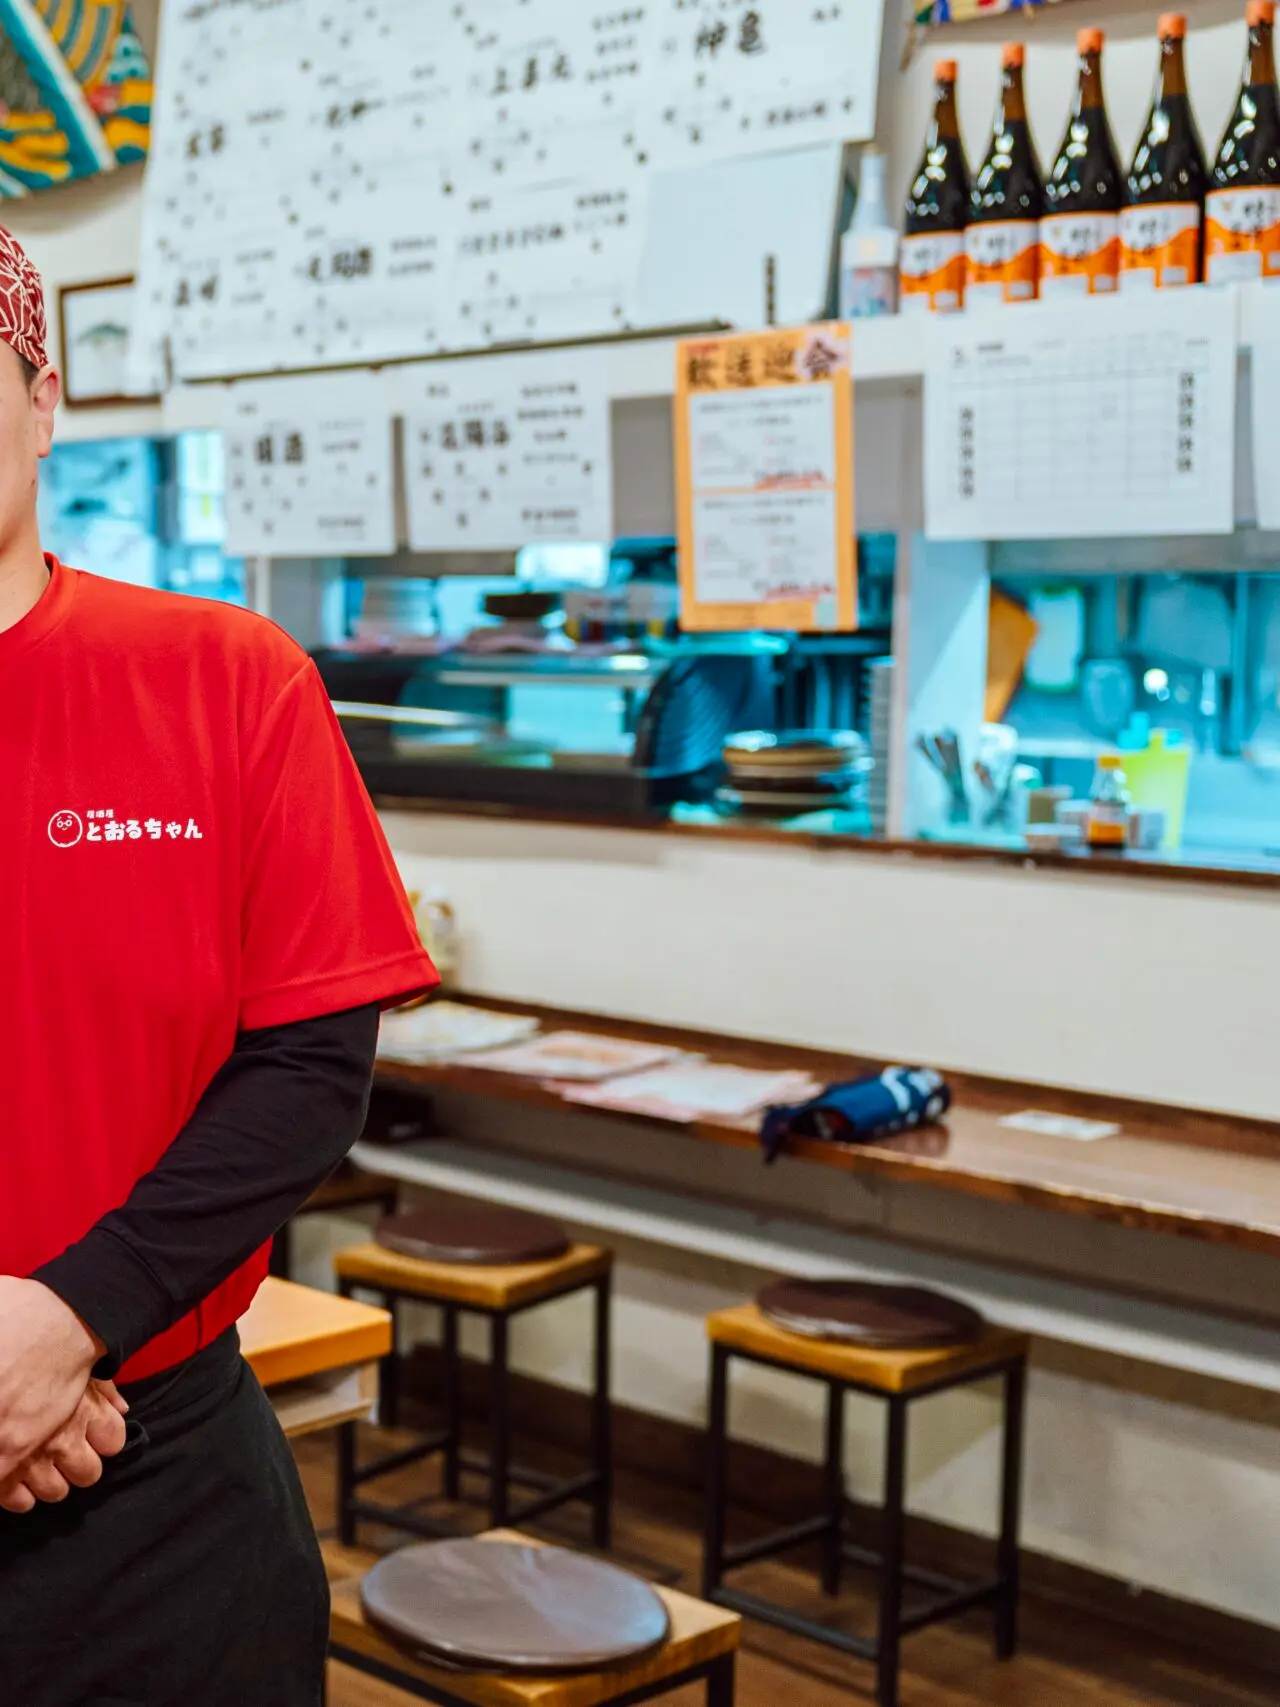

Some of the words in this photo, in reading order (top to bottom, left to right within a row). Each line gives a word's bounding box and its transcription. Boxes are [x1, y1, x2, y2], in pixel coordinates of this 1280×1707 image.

[86, 818, 203, 841] とおるちゃん
